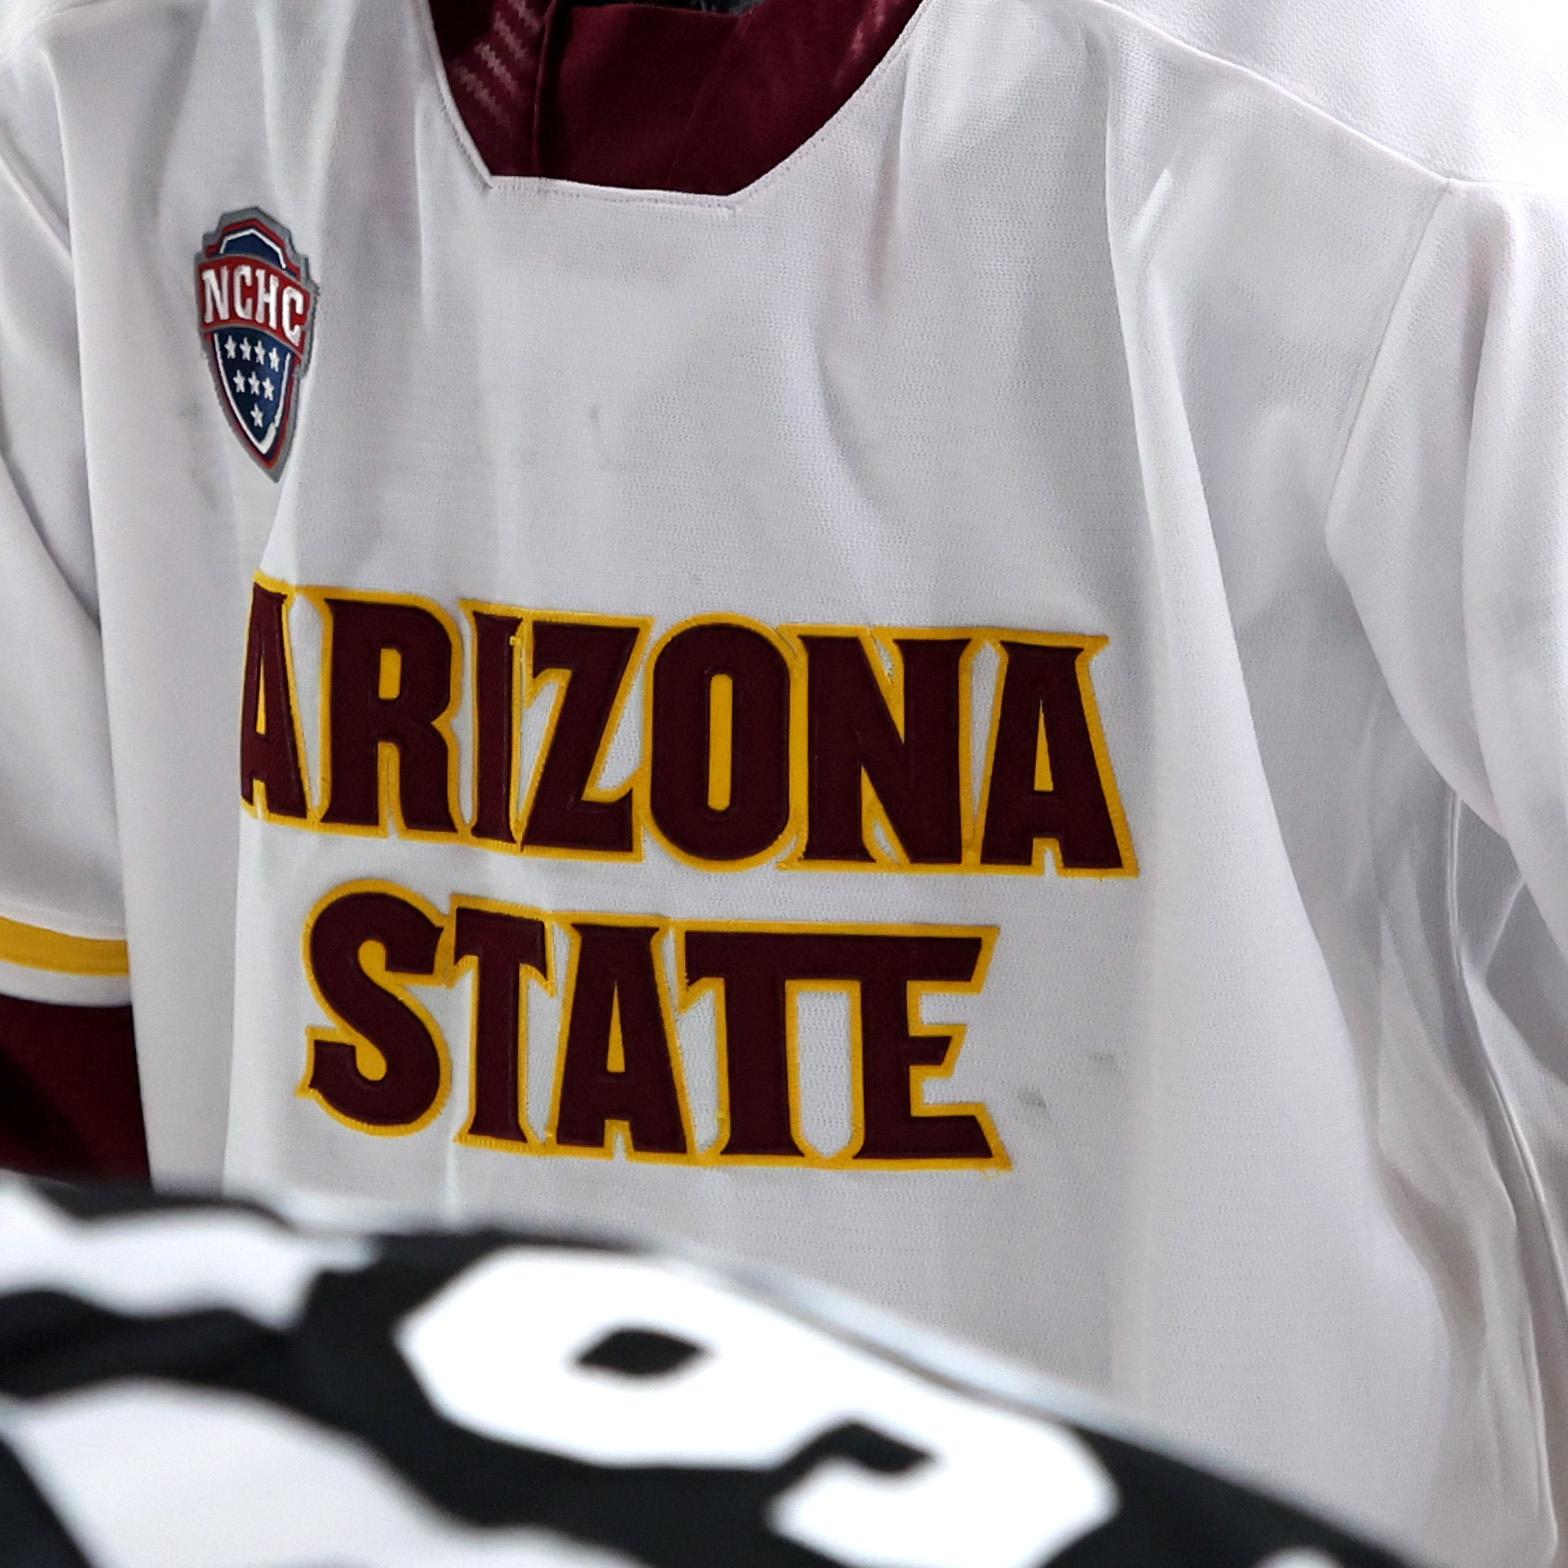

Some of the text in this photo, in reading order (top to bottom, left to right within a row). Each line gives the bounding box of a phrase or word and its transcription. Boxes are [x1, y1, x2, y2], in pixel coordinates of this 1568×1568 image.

[201, 264, 305, 347] NCHC
[240, 570, 1140, 878] ARIZONA
[294, 878, 1012, 1171] STATE
